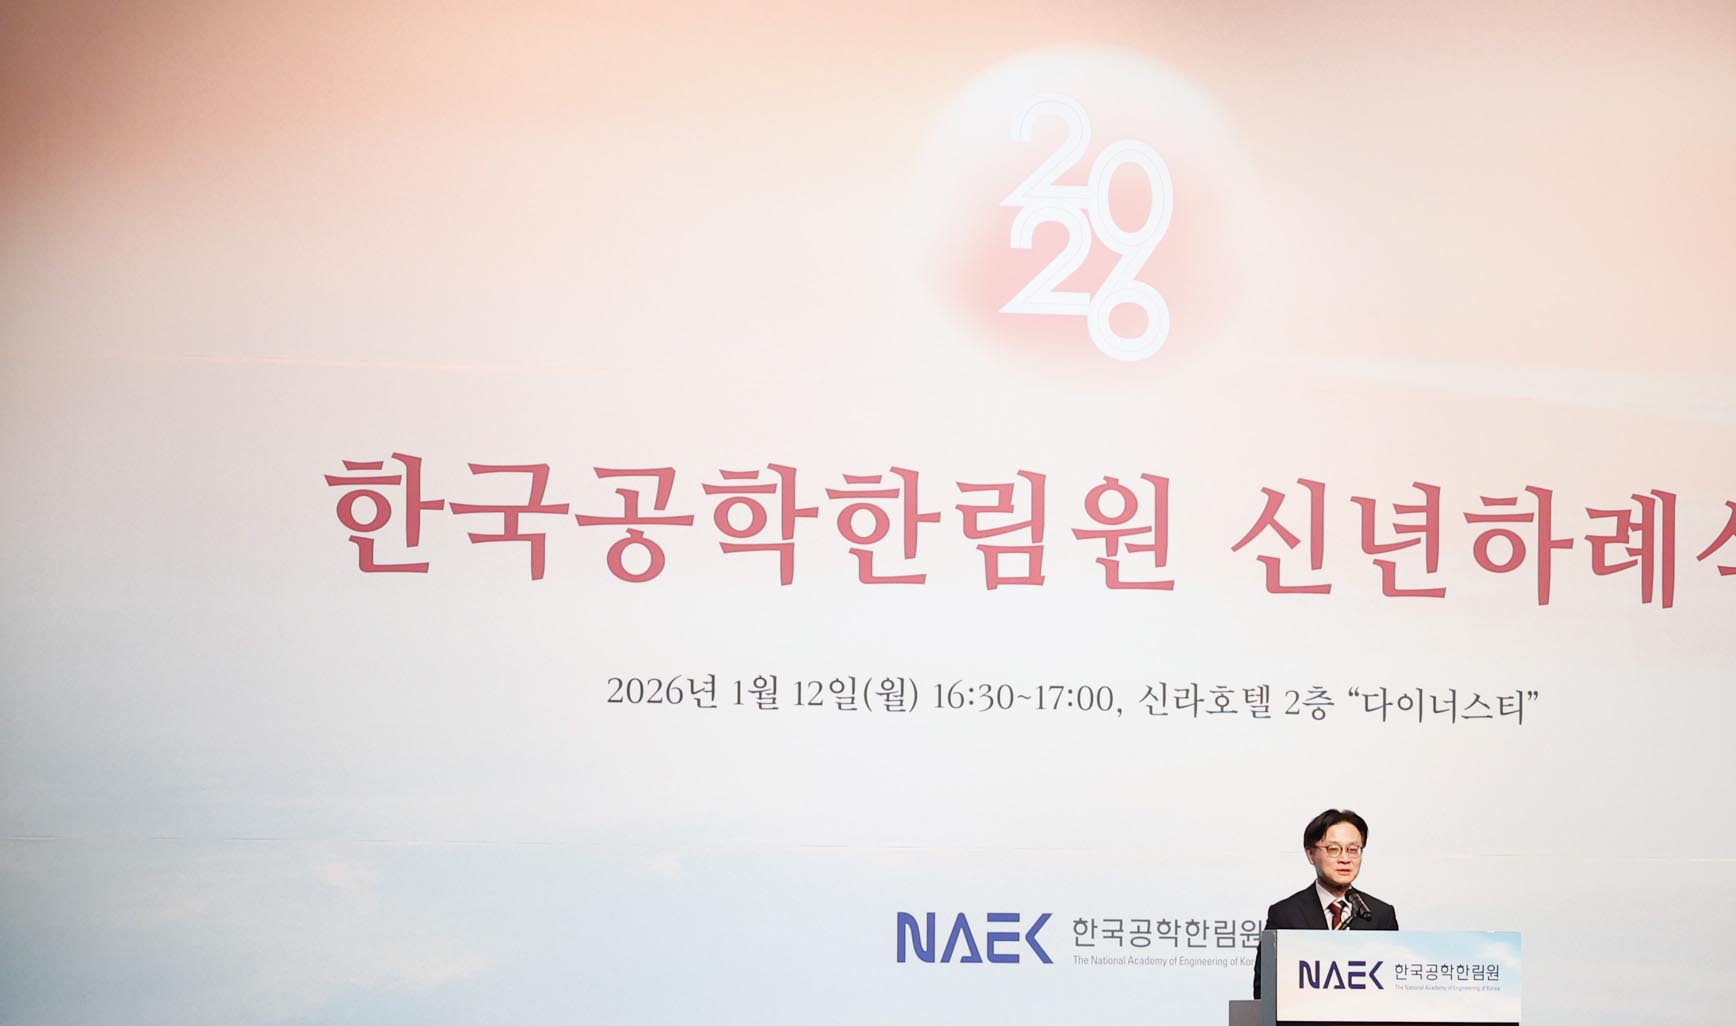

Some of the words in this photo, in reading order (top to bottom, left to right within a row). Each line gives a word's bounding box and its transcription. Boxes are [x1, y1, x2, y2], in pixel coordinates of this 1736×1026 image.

[323, 451, 1175, 591] 한국공학한림원
[607, 673, 718, 709] 2026년
[735, 674, 779, 711] 1월
[795, 675, 918, 713] 12일(월)
[936, 679, 1123, 718] 16:30~17:00,
[1139, 681, 1272, 719] 신라호텔
[1284, 685, 1335, 721] 2층
[896, 911, 1054, 965] NAEK
[1073, 917, 1262, 949] 한국공학한림원
[1073, 955, 1089, 966] The
[1091, 955, 1126, 966] National
[1128, 956, 1167, 968] Academy
[1169, 956, 1178, 967] of
[1180, 956, 1228, 969] Engineering
[1229, 956, 1239, 967] of
[1298, 960, 1385, 990] NAEK
[1395, 963, 1500, 981] 한국공학한림원
